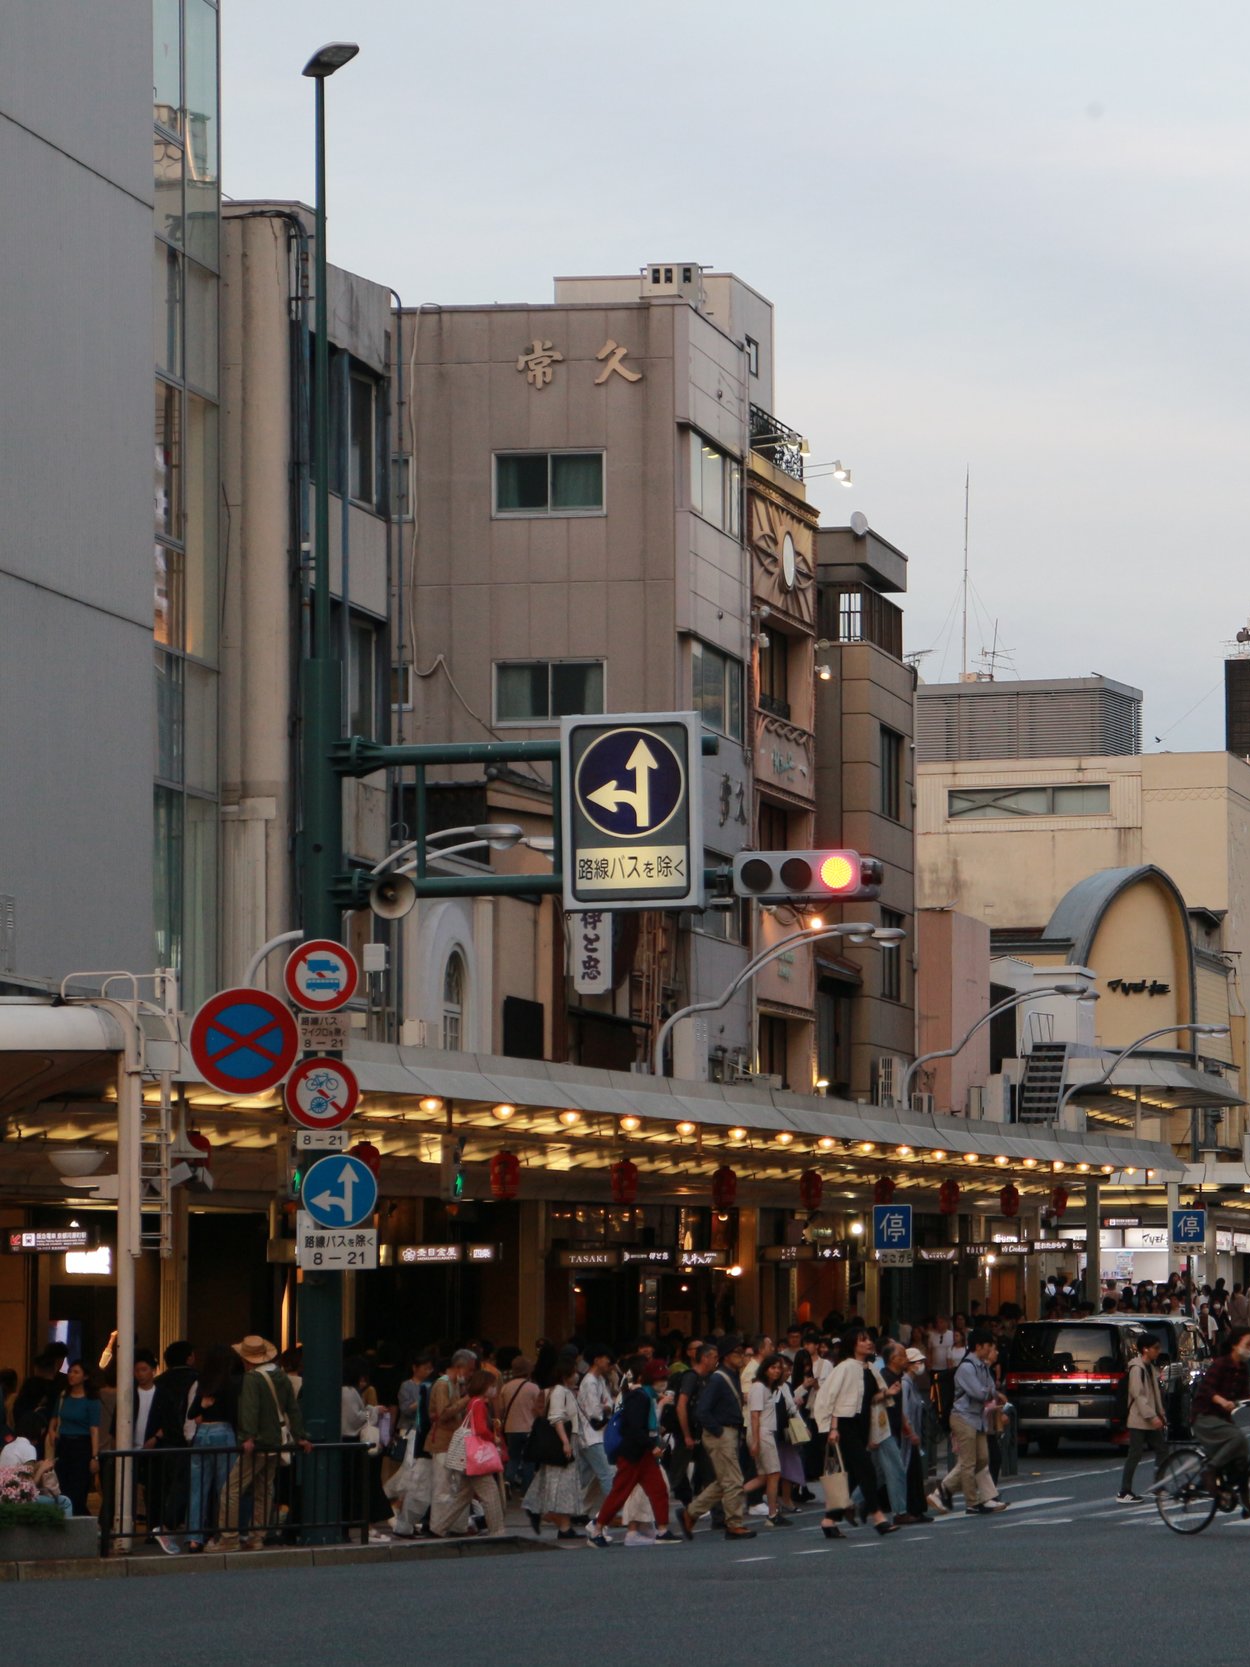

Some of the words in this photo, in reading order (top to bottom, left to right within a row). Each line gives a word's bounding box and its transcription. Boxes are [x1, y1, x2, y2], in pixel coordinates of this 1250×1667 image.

[516, 339, 642, 390] 常久
[577, 854, 685, 881] 路線バスを除く
[880, 1213, 906, 1242] 停
[1177, 1215, 1200, 1238] 停
[304, 1234, 374, 1249] 路線バスを除く
[1173, 1245, 1203, 1253] ここまで
[568, 1255, 608, 1263] TASAKI
[881, 1253, 913, 1264] ここから
